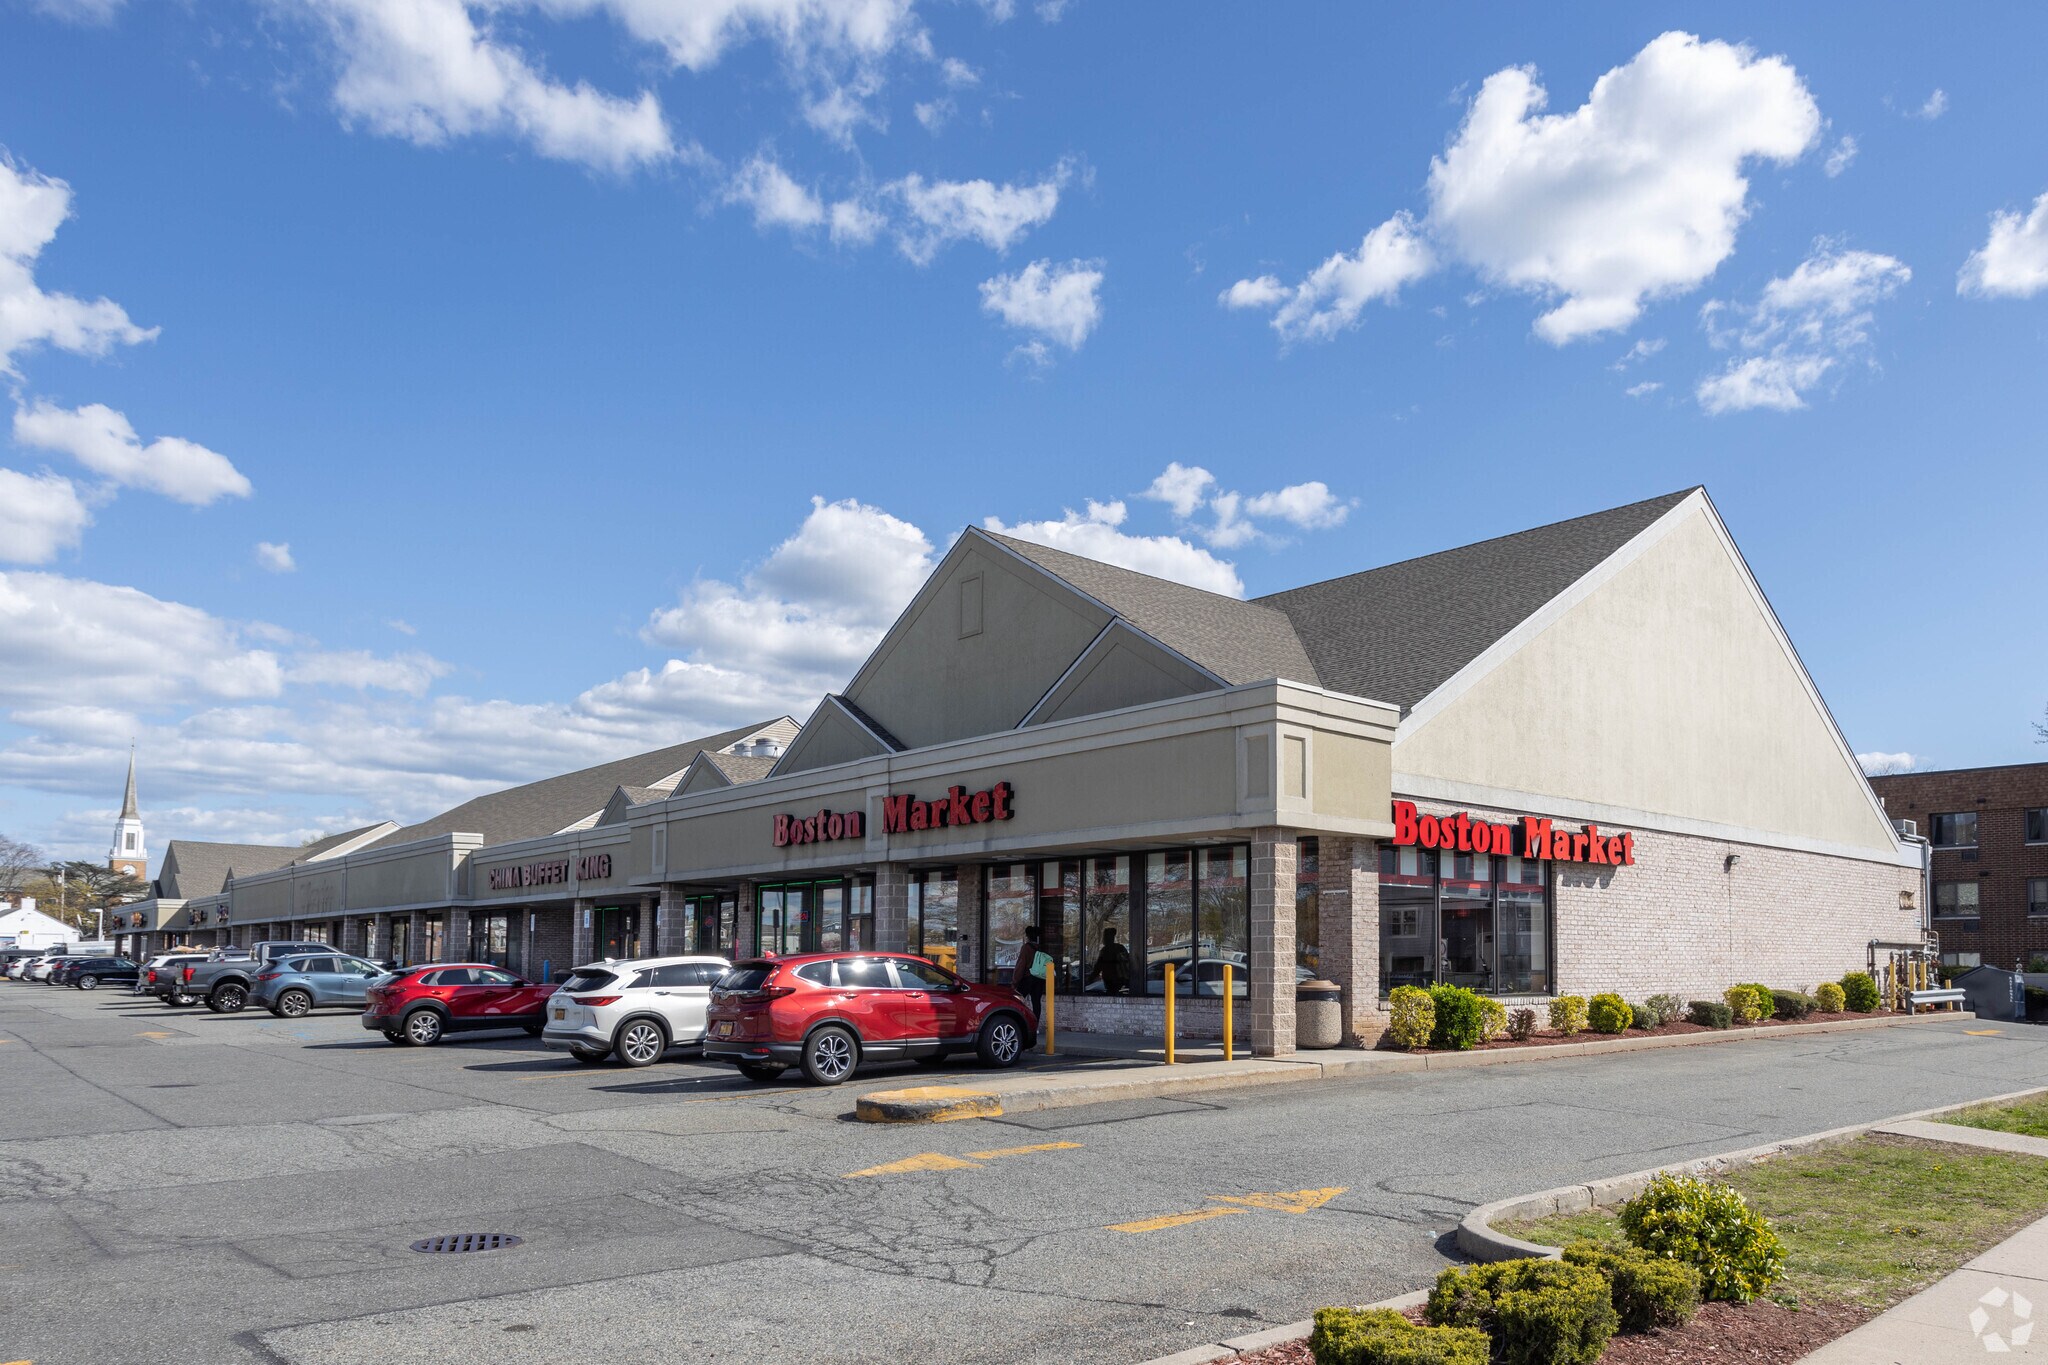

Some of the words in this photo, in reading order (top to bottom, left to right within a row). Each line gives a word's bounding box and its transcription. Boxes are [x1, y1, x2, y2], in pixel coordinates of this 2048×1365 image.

[773, 809, 865, 847] Boston
[882, 781, 1014, 834] Market
[1392, 799, 1512, 855] Boston
[1519, 815, 1635, 866] Market
[489, 867, 522, 890] CHINA
[523, 859, 569, 886] BUFFET
[575, 854, 611, 881] KING
